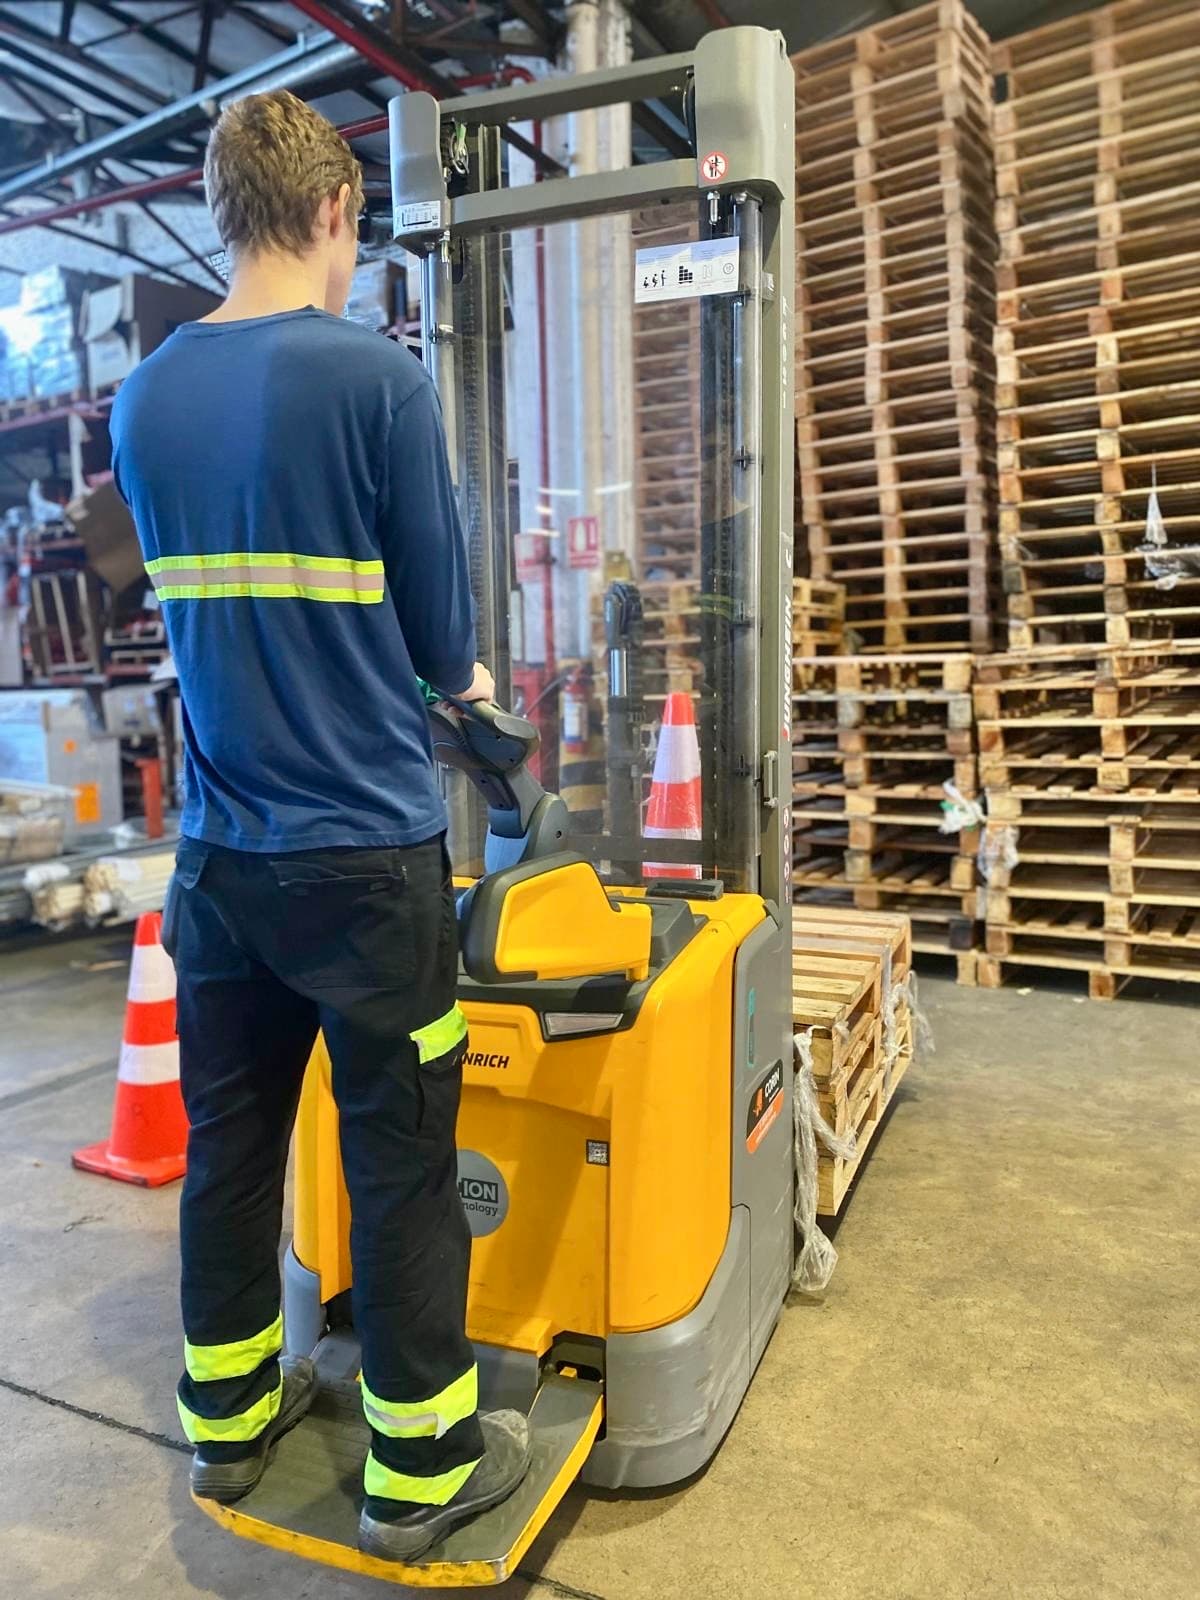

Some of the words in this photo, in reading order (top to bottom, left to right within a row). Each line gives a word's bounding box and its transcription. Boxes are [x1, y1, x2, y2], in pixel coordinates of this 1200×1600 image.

[462, 1052, 510, 1069] NRICH
[460, 1179, 497, 1202] ION
[463, 1201, 498, 1217] nology
